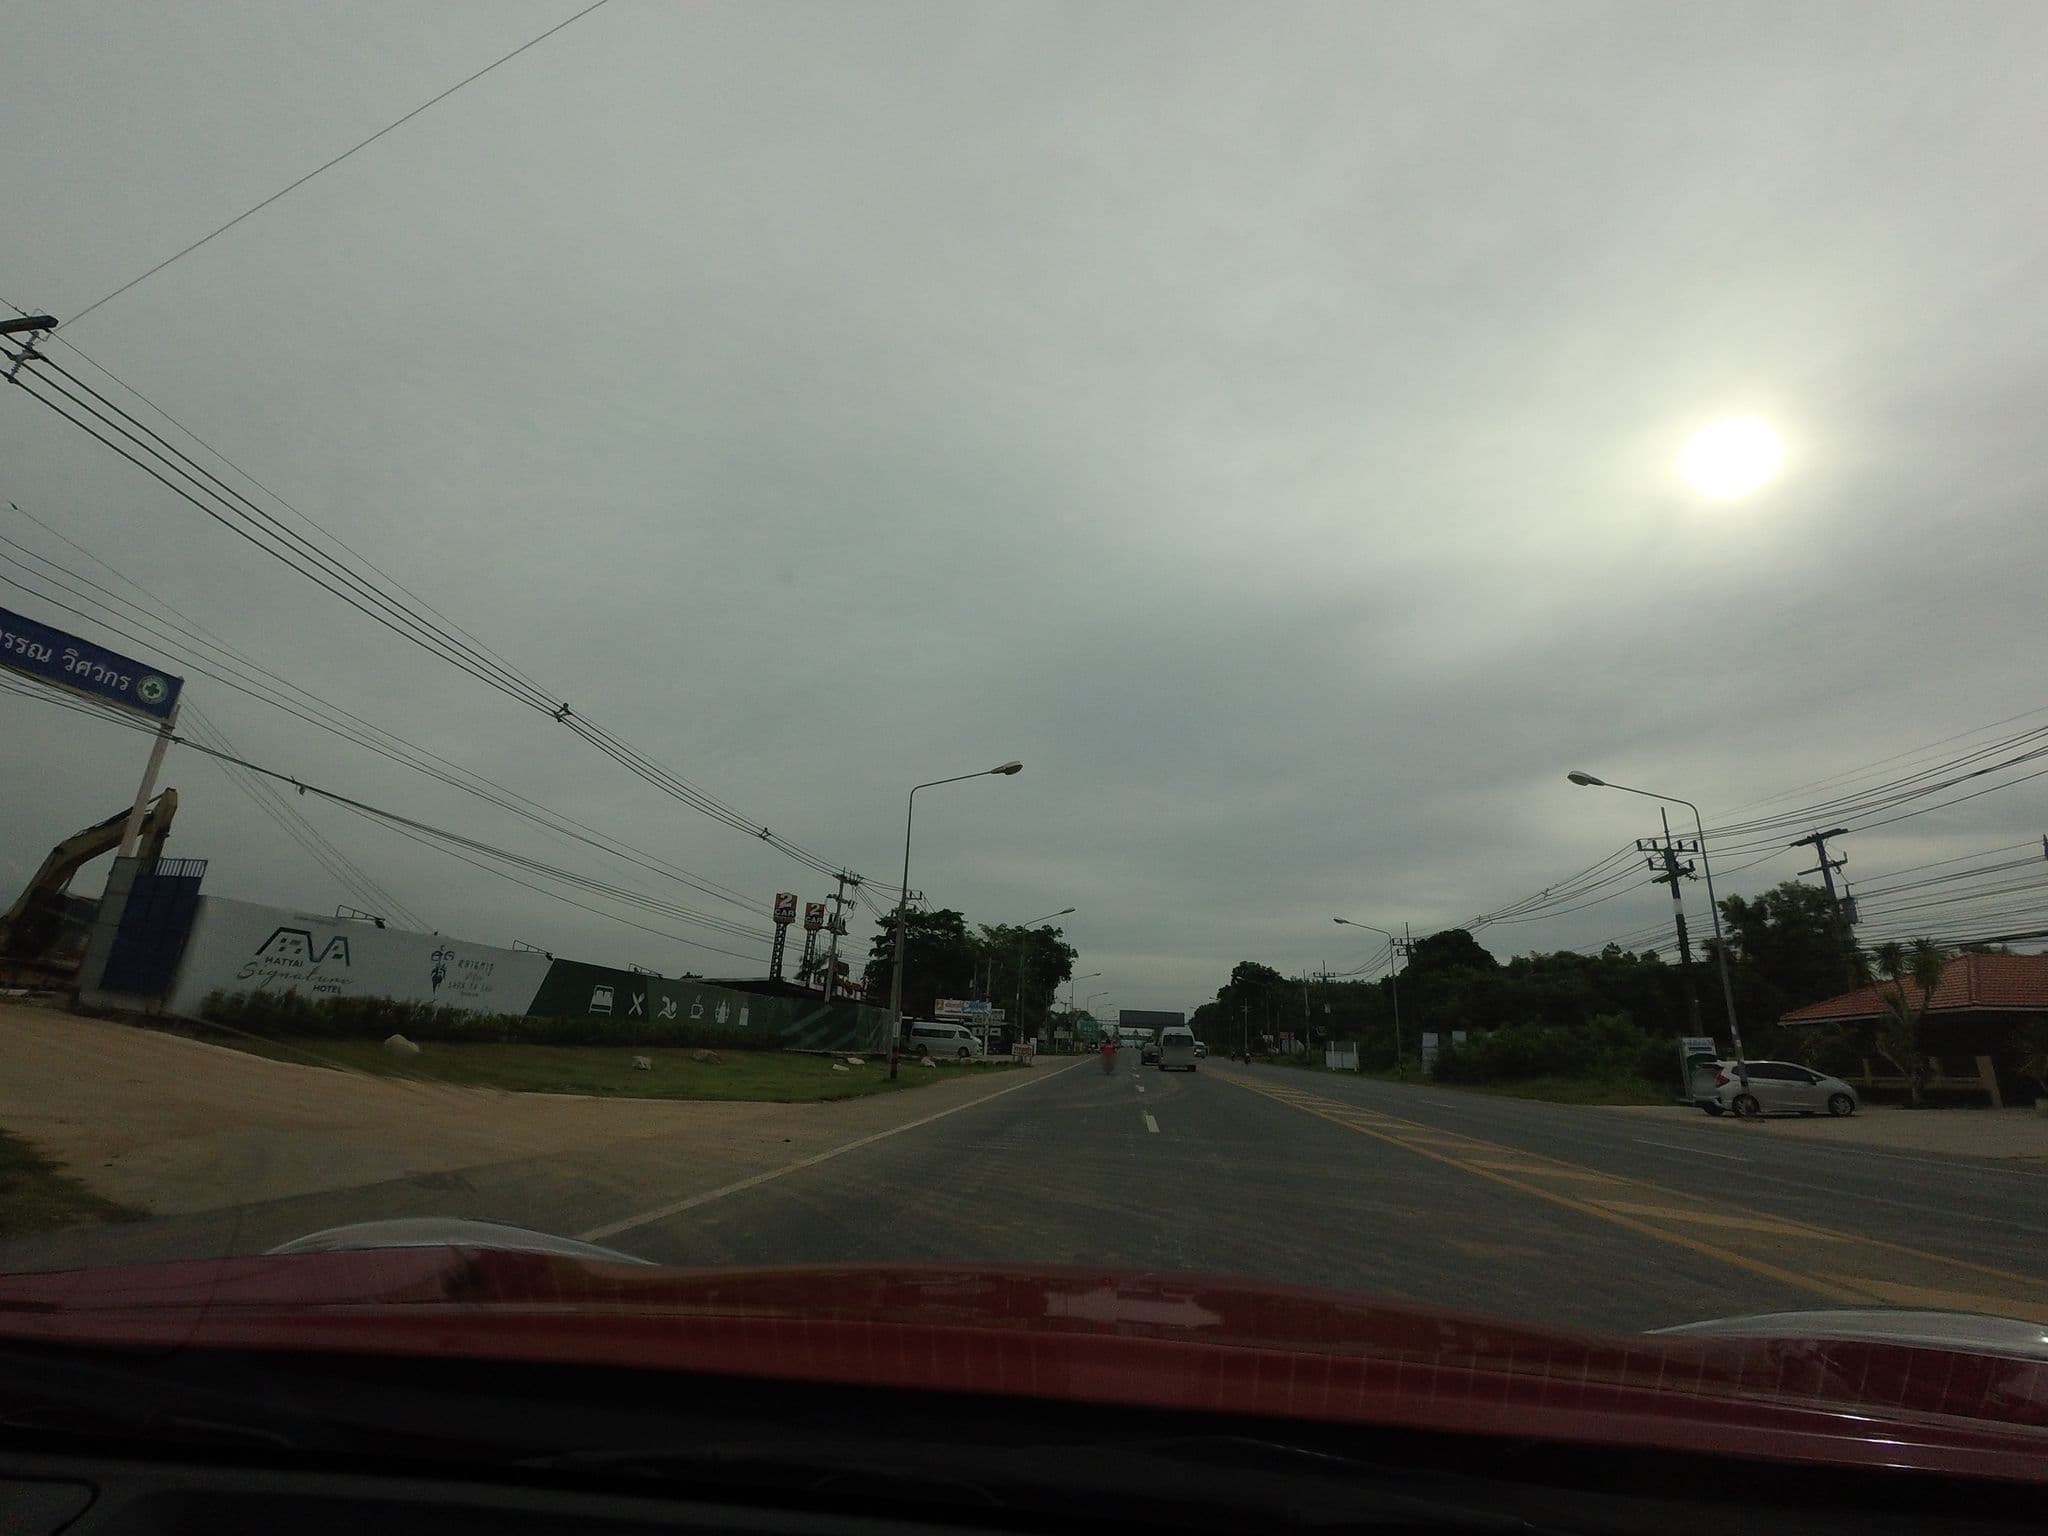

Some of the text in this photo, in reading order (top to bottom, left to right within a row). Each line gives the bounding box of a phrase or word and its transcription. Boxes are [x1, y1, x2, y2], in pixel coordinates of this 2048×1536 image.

[62, 648, 132, 691] วิศวกร
[265, 956, 304, 968] HATYAI
[313, 985, 343, 994] HOTEL
